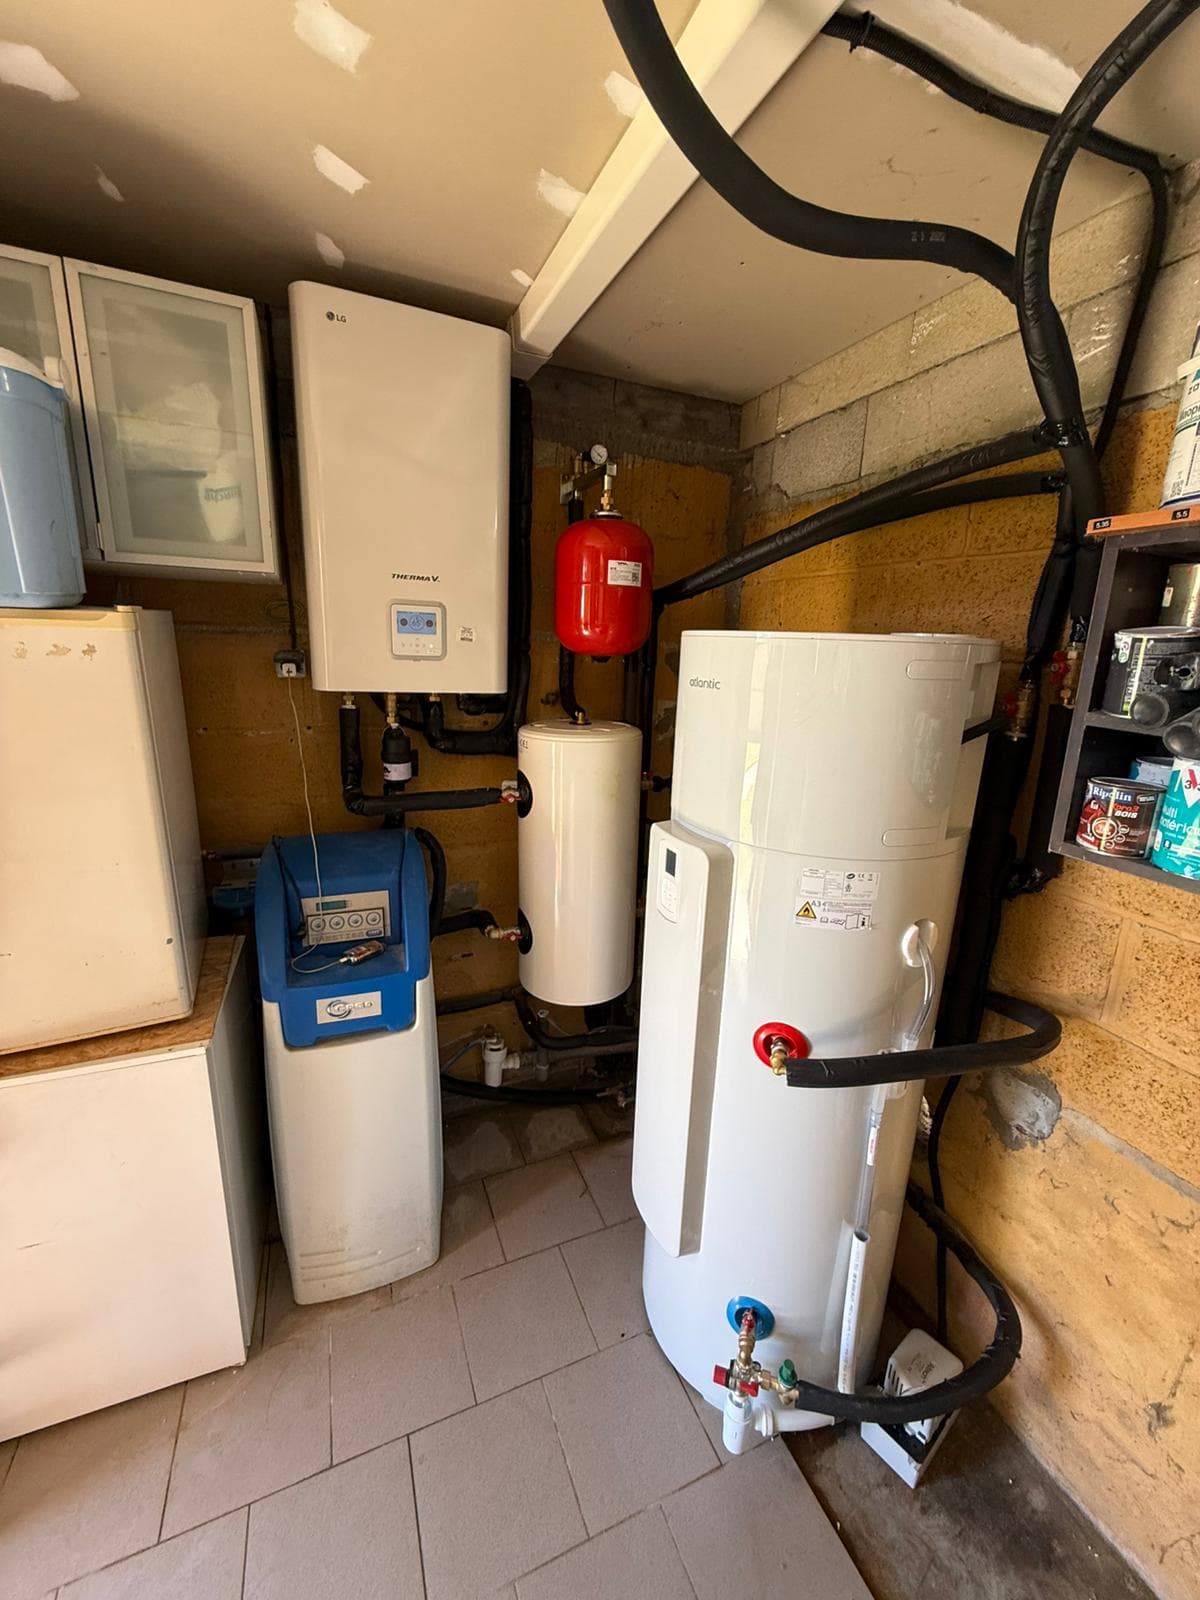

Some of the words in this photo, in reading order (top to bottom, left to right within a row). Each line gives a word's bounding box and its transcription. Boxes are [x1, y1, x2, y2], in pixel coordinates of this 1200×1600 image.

[336, 314, 346, 323] LG
[391, 573, 431, 582] THERMA
[689, 676, 720, 690] atlantic
[1093, 786, 1132, 801] Ripolin
[1114, 810, 1138, 819] BOIS
